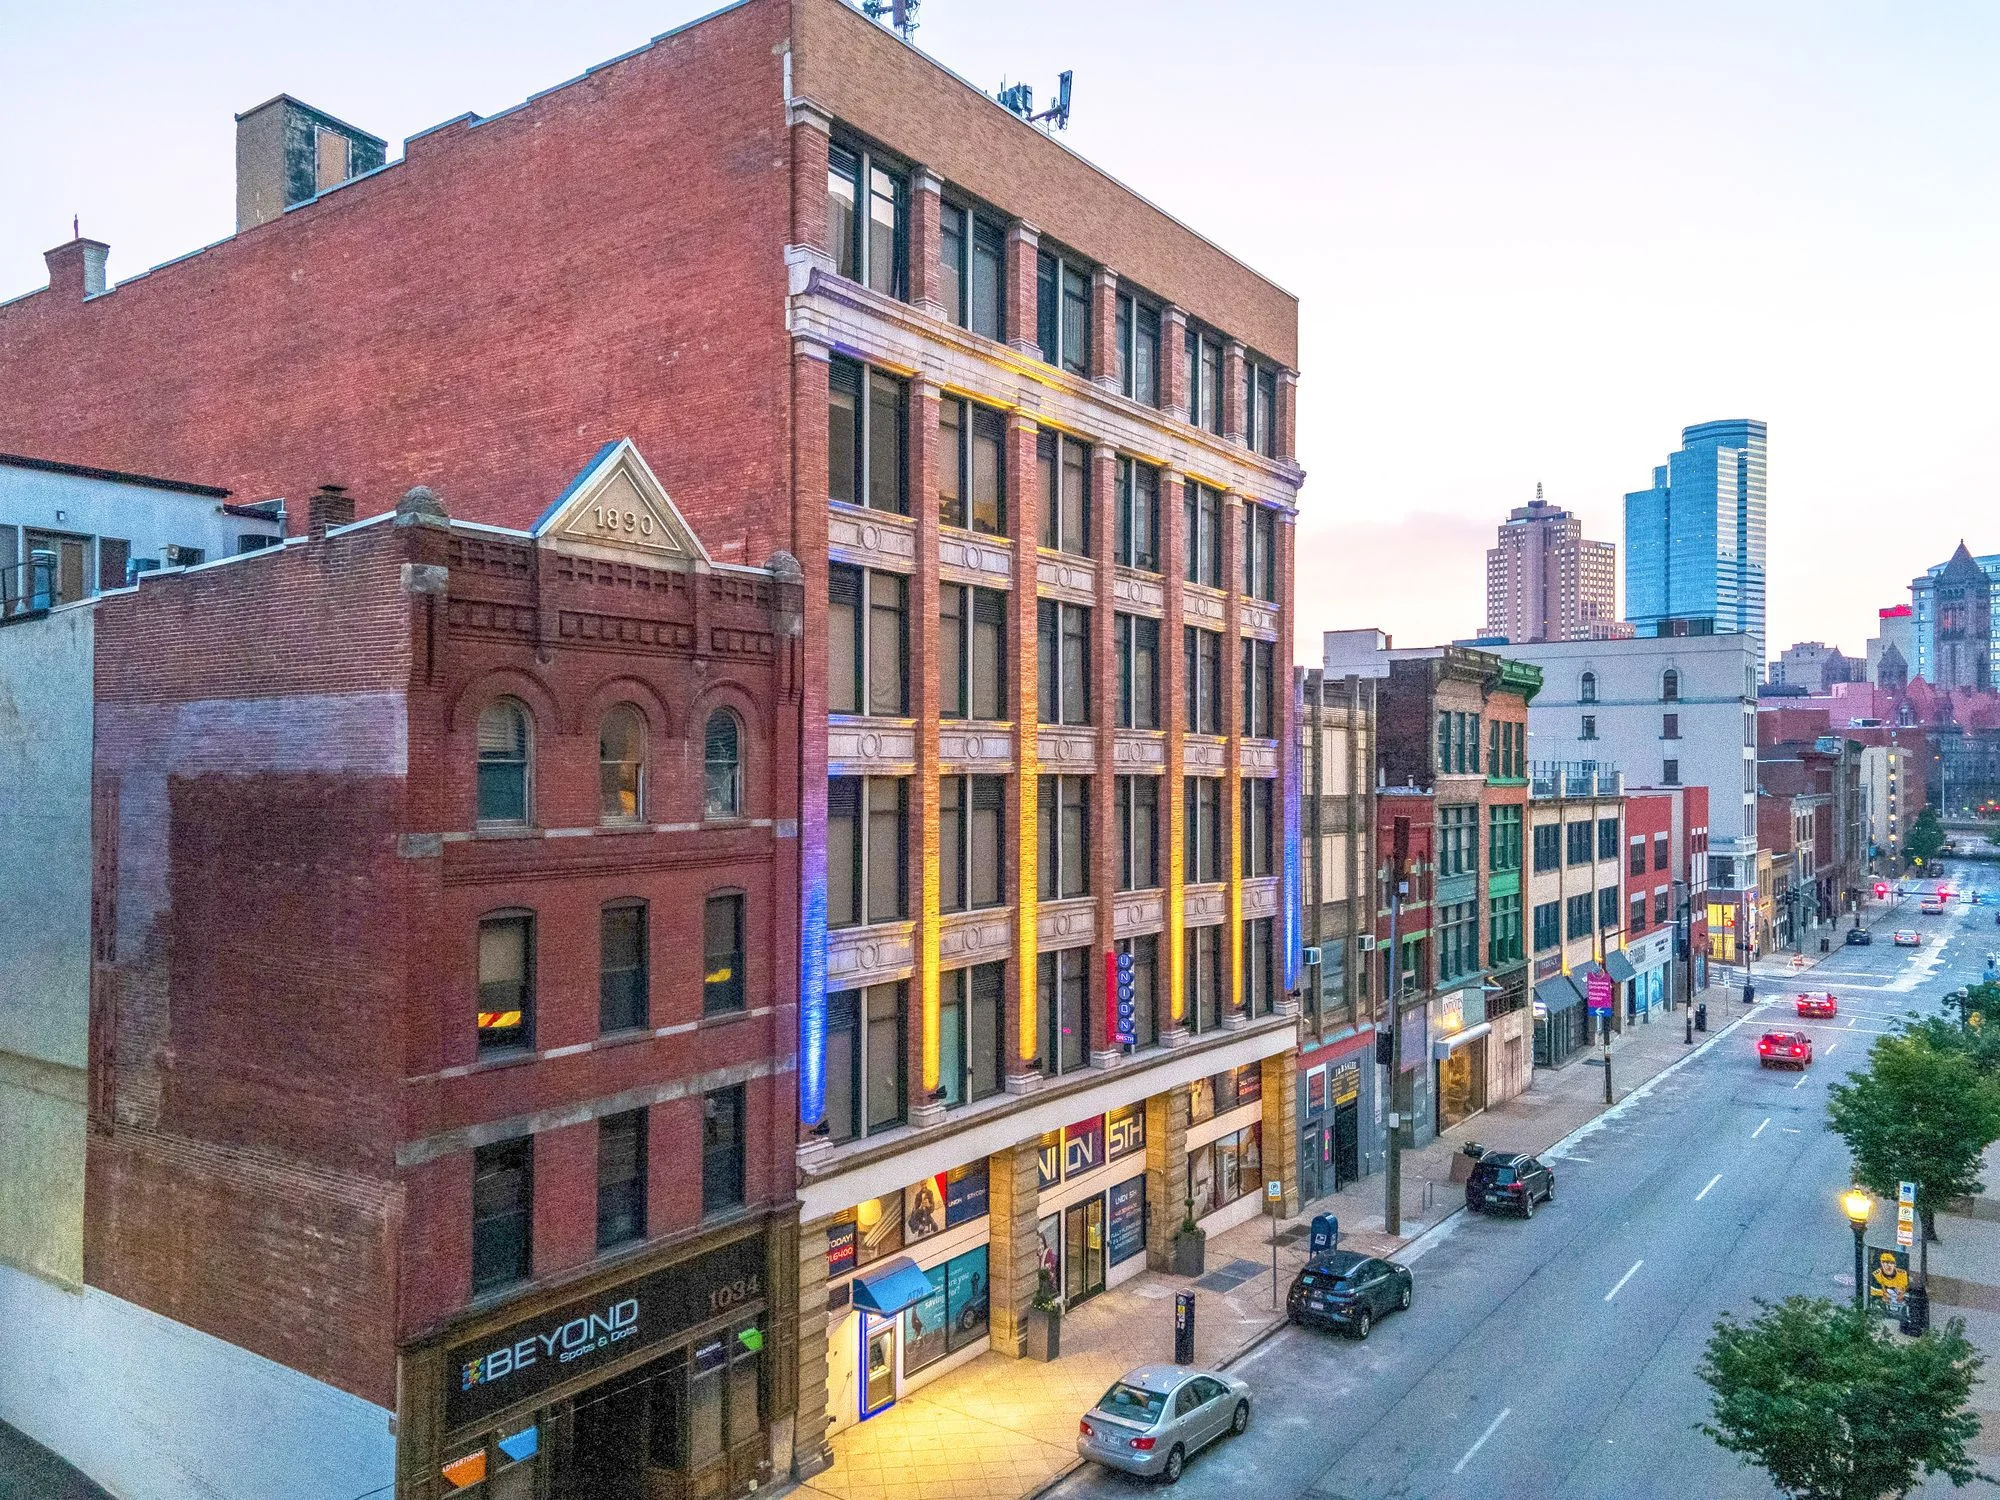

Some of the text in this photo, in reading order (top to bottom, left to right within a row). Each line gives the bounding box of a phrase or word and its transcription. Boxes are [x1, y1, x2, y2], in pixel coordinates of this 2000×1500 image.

[594, 505, 654, 536] 1890
[1120, 957, 1129, 1029] UNION
[1110, 1114, 1143, 1154] 5TH
[708, 1274, 759, 1309] 1034
[906, 1286, 924, 1302] ATM
[486, 1299, 638, 1381] BEYOND
[559, 1325, 638, 1363] Spots & Dots
[442, 1448, 486, 1472] ADVERTISING
